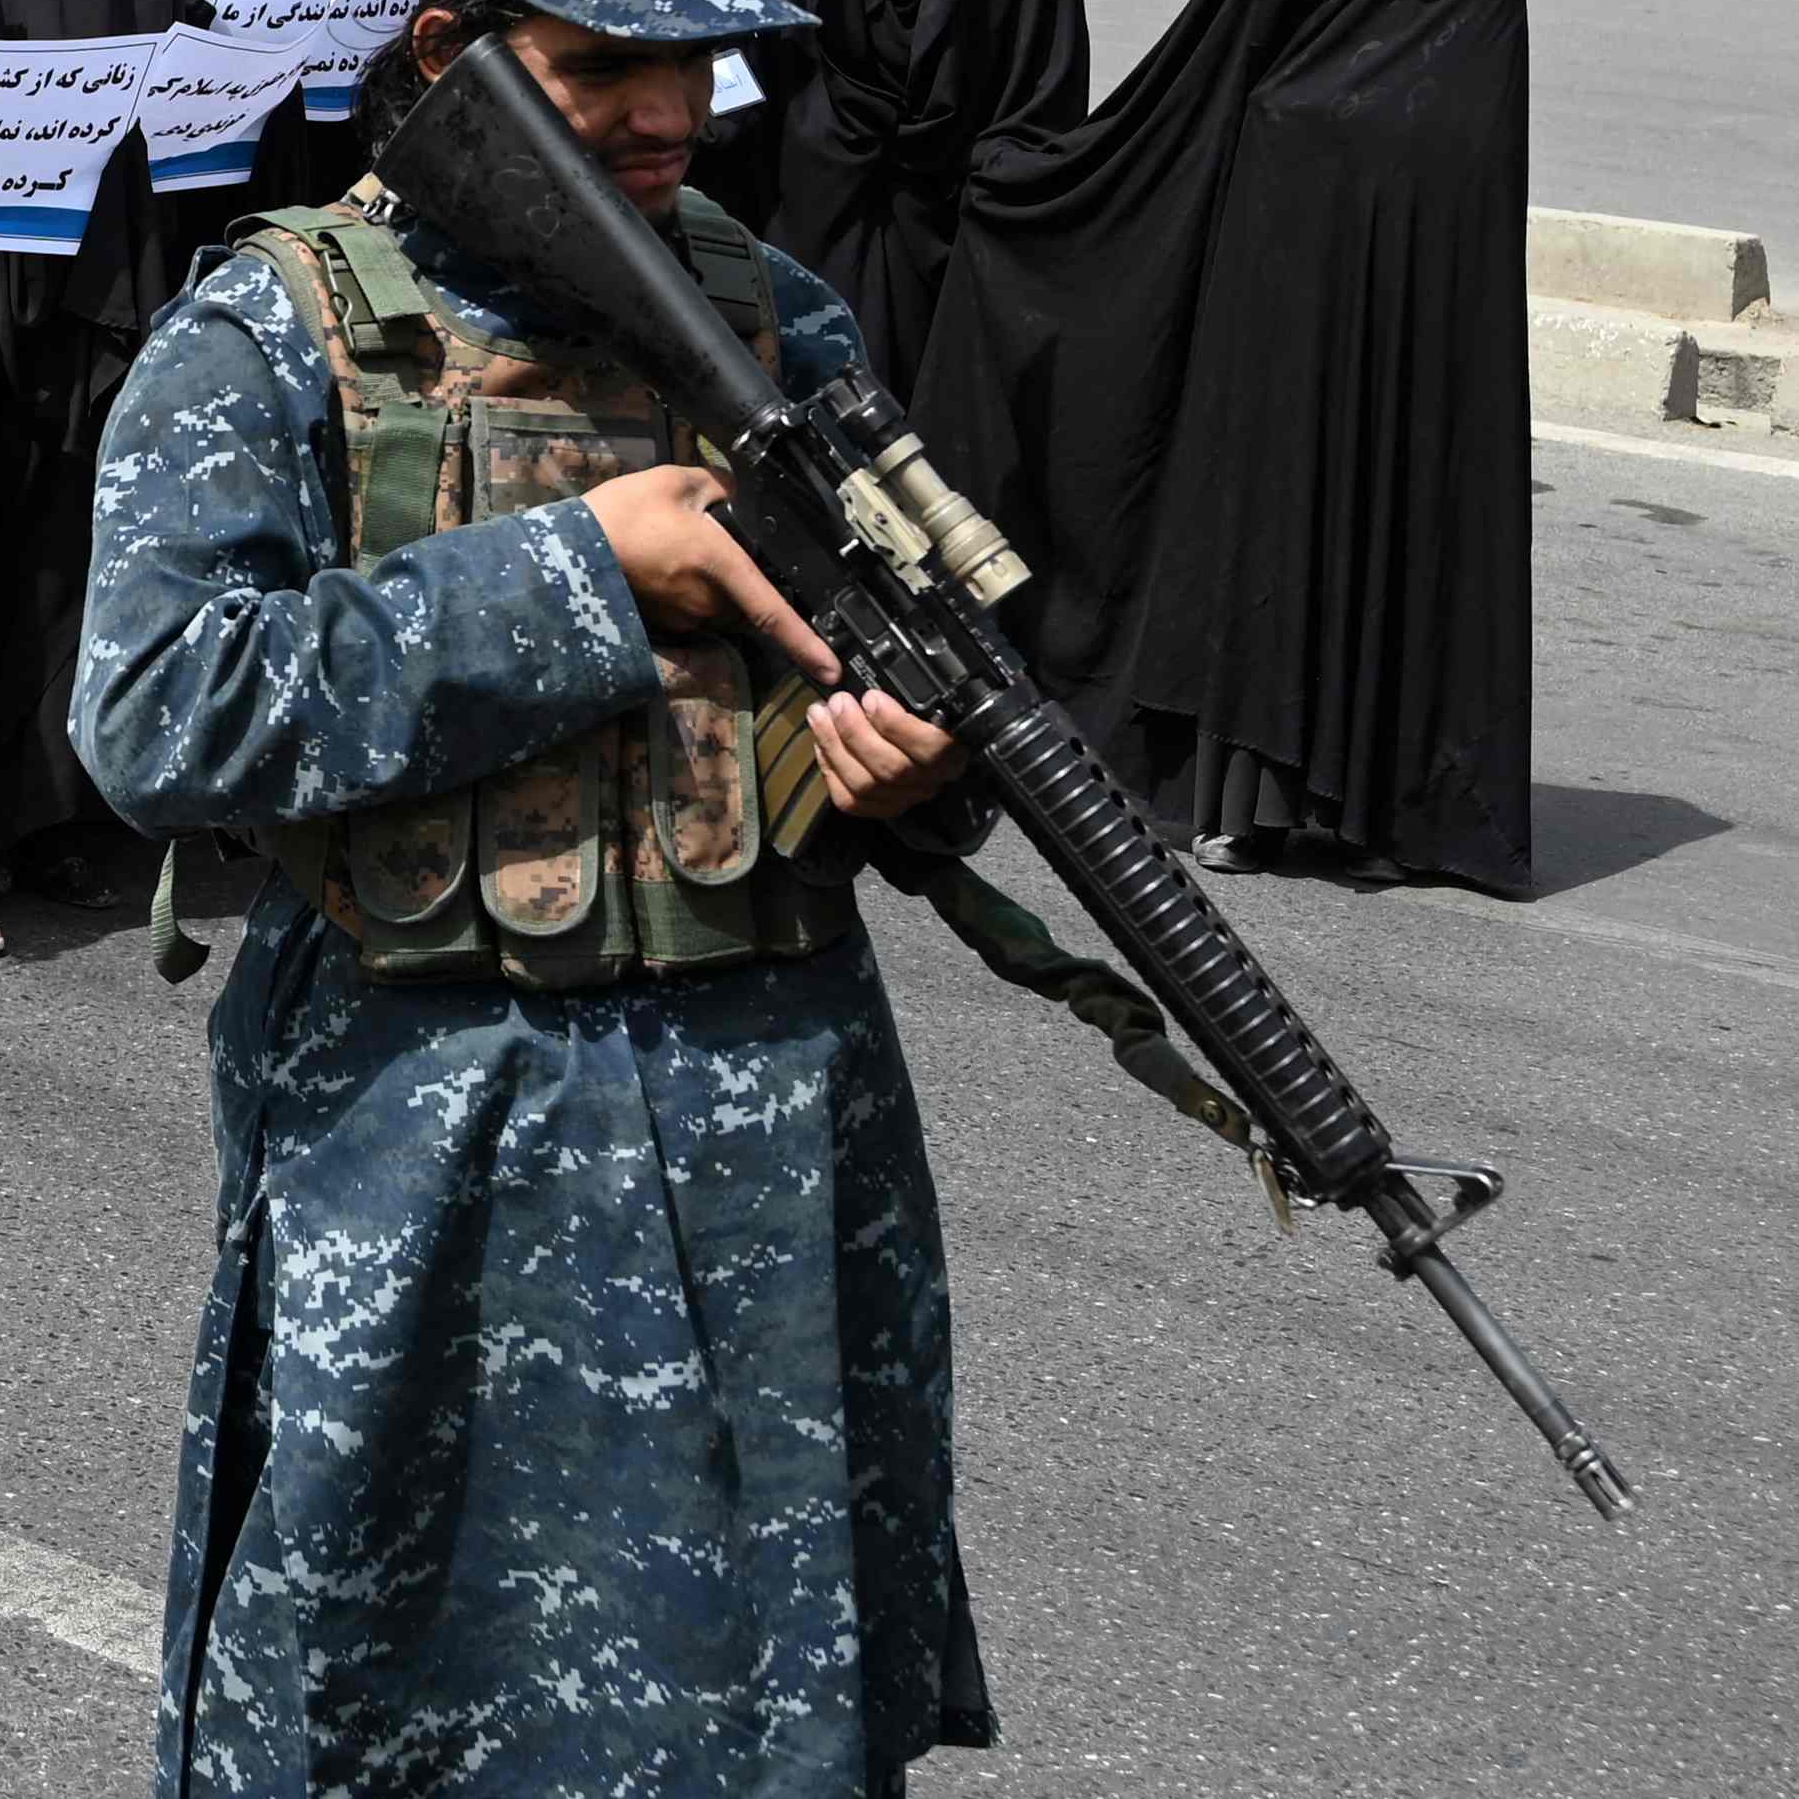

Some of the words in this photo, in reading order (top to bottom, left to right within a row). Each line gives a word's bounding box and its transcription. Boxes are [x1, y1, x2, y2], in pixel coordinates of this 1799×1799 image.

[221, 2, 240, 22] ما
[241, 2, 268, 29] از
[25, 67, 54, 97] از
[54, 65, 84, 89] که
[82, 62, 136, 94] زنانی
[67, 115, 122, 145] کرده
[2, 168, 74, 198] کرده
